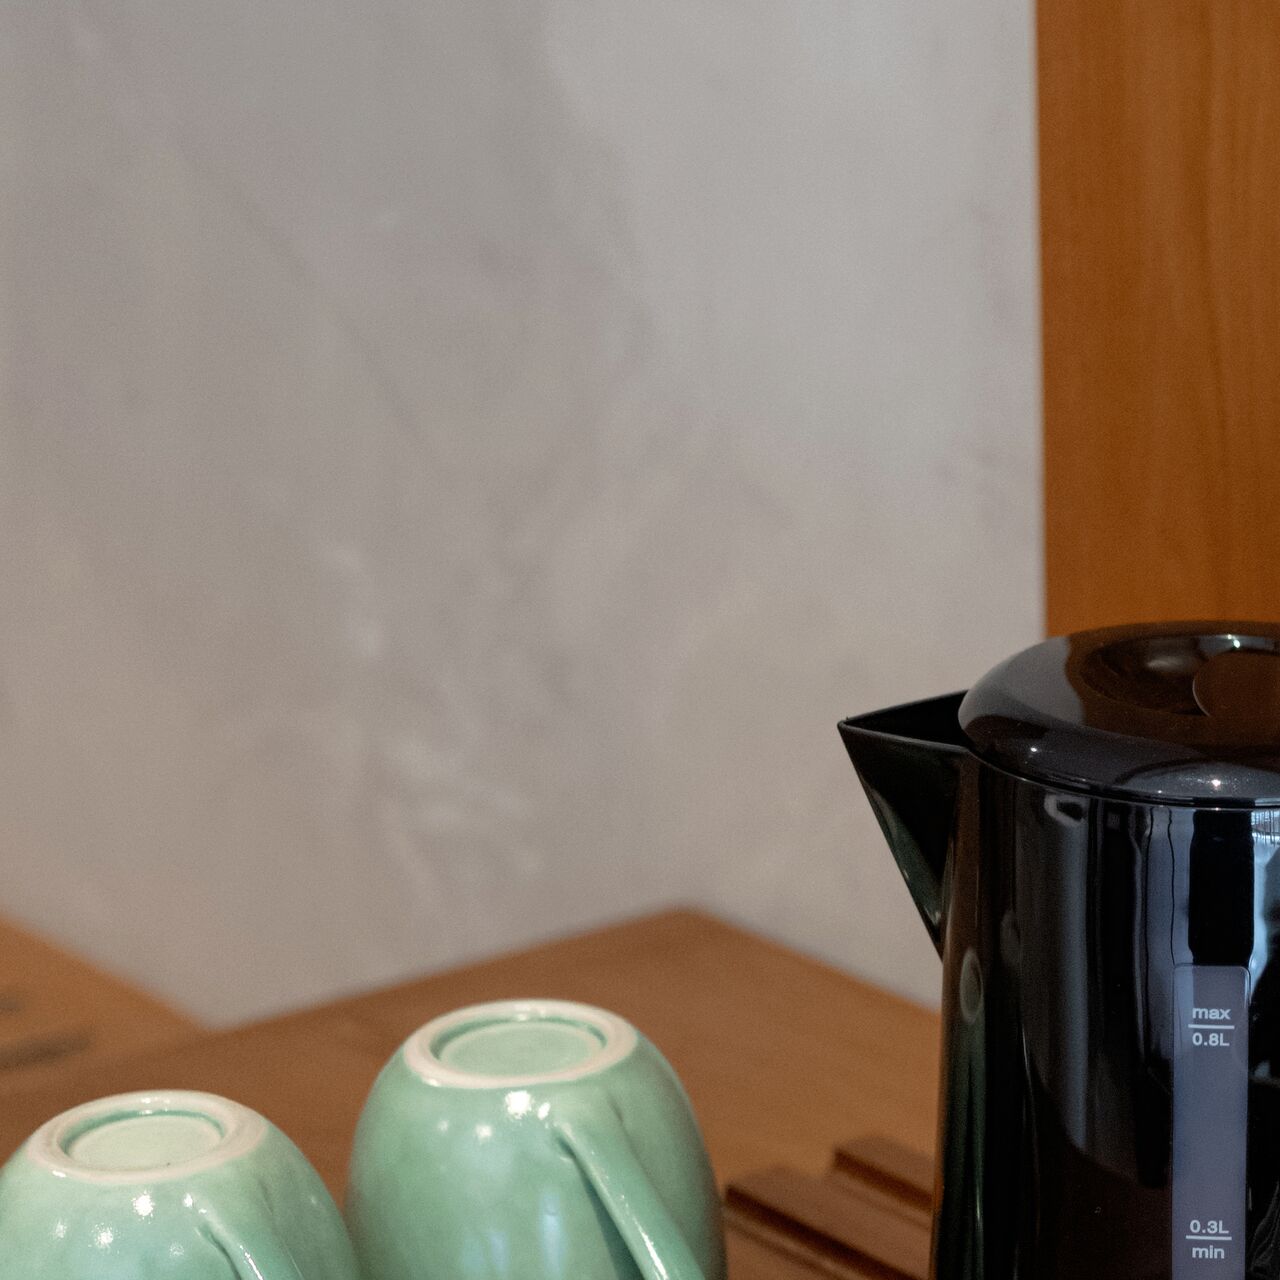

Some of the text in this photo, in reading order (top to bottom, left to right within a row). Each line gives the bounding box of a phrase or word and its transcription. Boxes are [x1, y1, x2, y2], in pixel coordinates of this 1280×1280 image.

[1191, 1006, 1231, 1020] max
[1191, 1032, 1230, 1047] 0.8L
[1189, 1219, 1229, 1235] 0.3L
[1191, 1244, 1225, 1260] min
